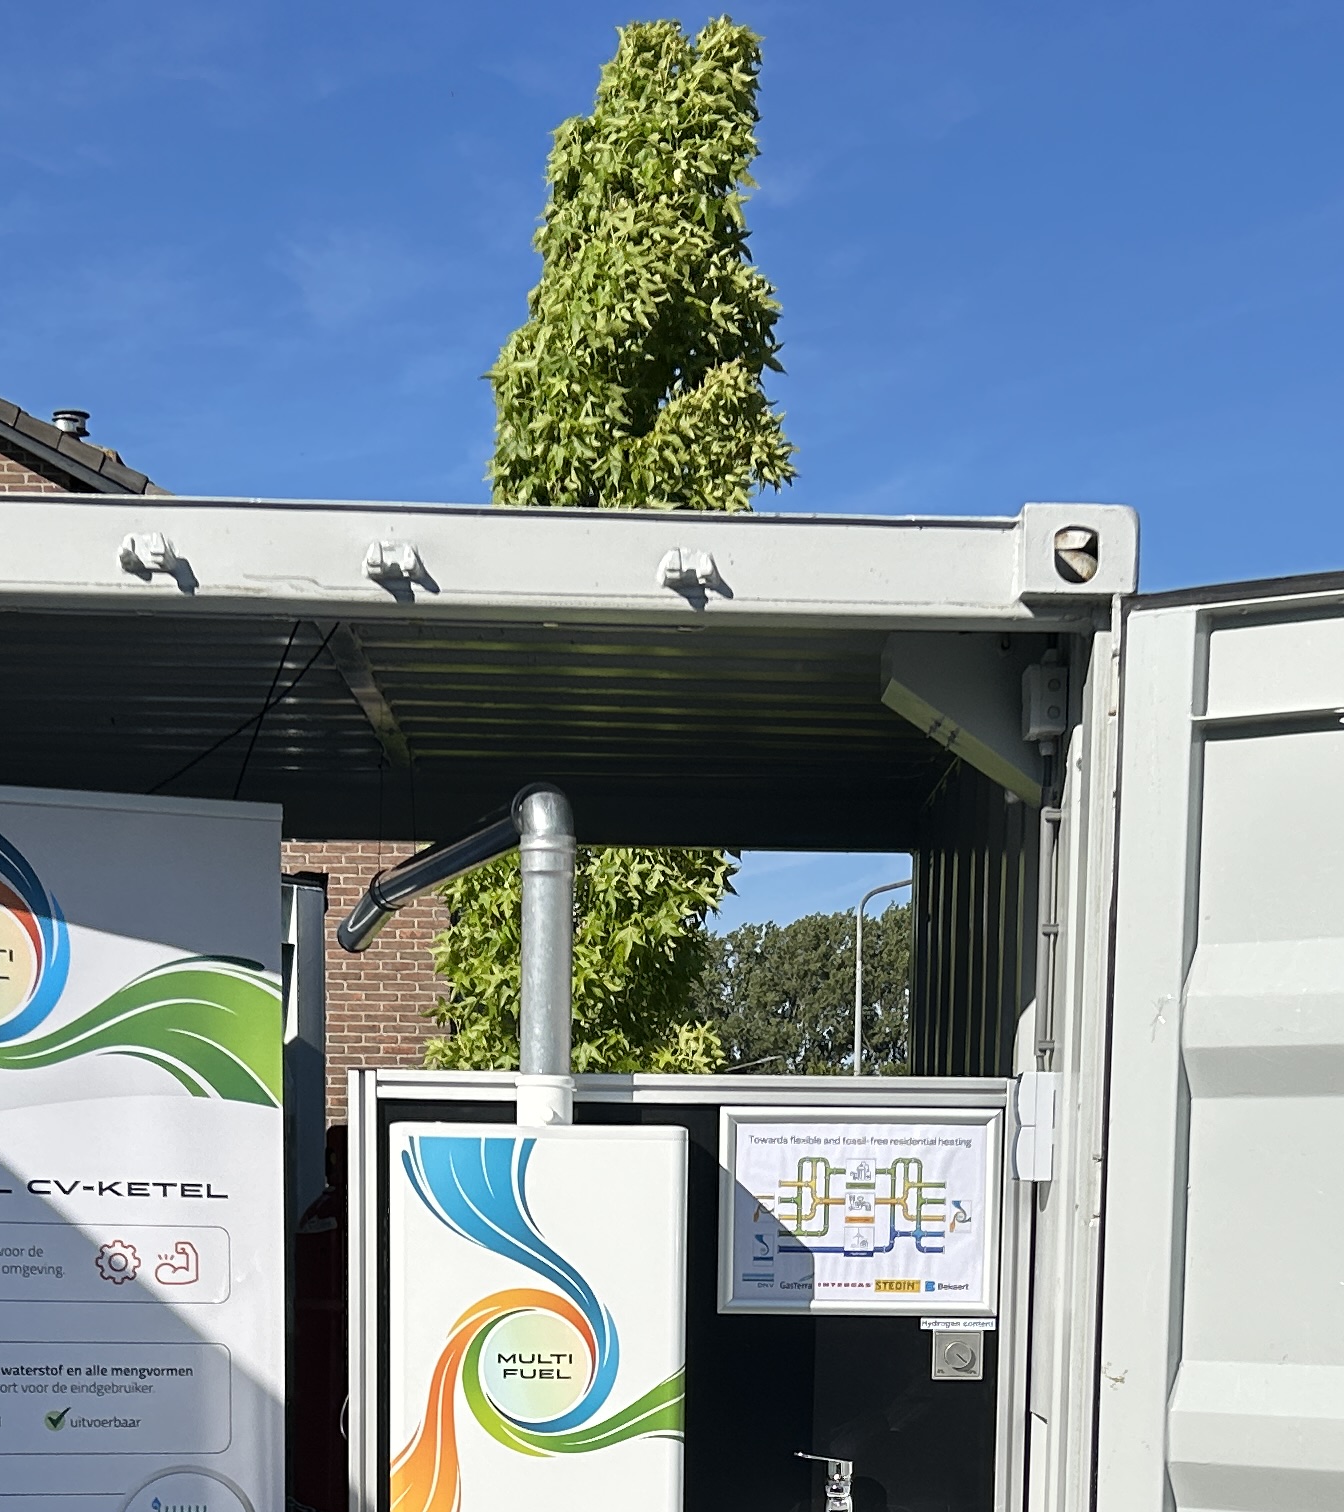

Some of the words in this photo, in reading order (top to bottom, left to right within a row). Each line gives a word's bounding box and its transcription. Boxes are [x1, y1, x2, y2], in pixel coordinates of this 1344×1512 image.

[748, 1135, 788, 1145] Towards
[790, 1135, 822, 1145] flexible
[824, 1136, 841, 1145] and
[890, 1137, 937, 1146] residential
[938, 1137, 972, 1149] heating
[25, 1178, 229, 1200] CV-KETEL
[28, 1245, 44, 1258] de
[1, 1263, 66, 1279] omgeving.
[780, 1281, 813, 1290] GasTerra
[922, 1319, 961, 1329] Hydrogen
[497, 1353, 573, 1365] MULTI
[1, 1364, 64, 1377] waterstof
[67, 1367, 82, 1377] en
[85, 1365, 108, 1377] alle
[111, 1366, 193, 1379] mengvormen
[503, 1368, 572, 1380] FUEL
[21, 1384, 50, 1394] voor
[52, 1381, 68, 1394] de
[70, 1415, 141, 1429] uitvoerbaar
